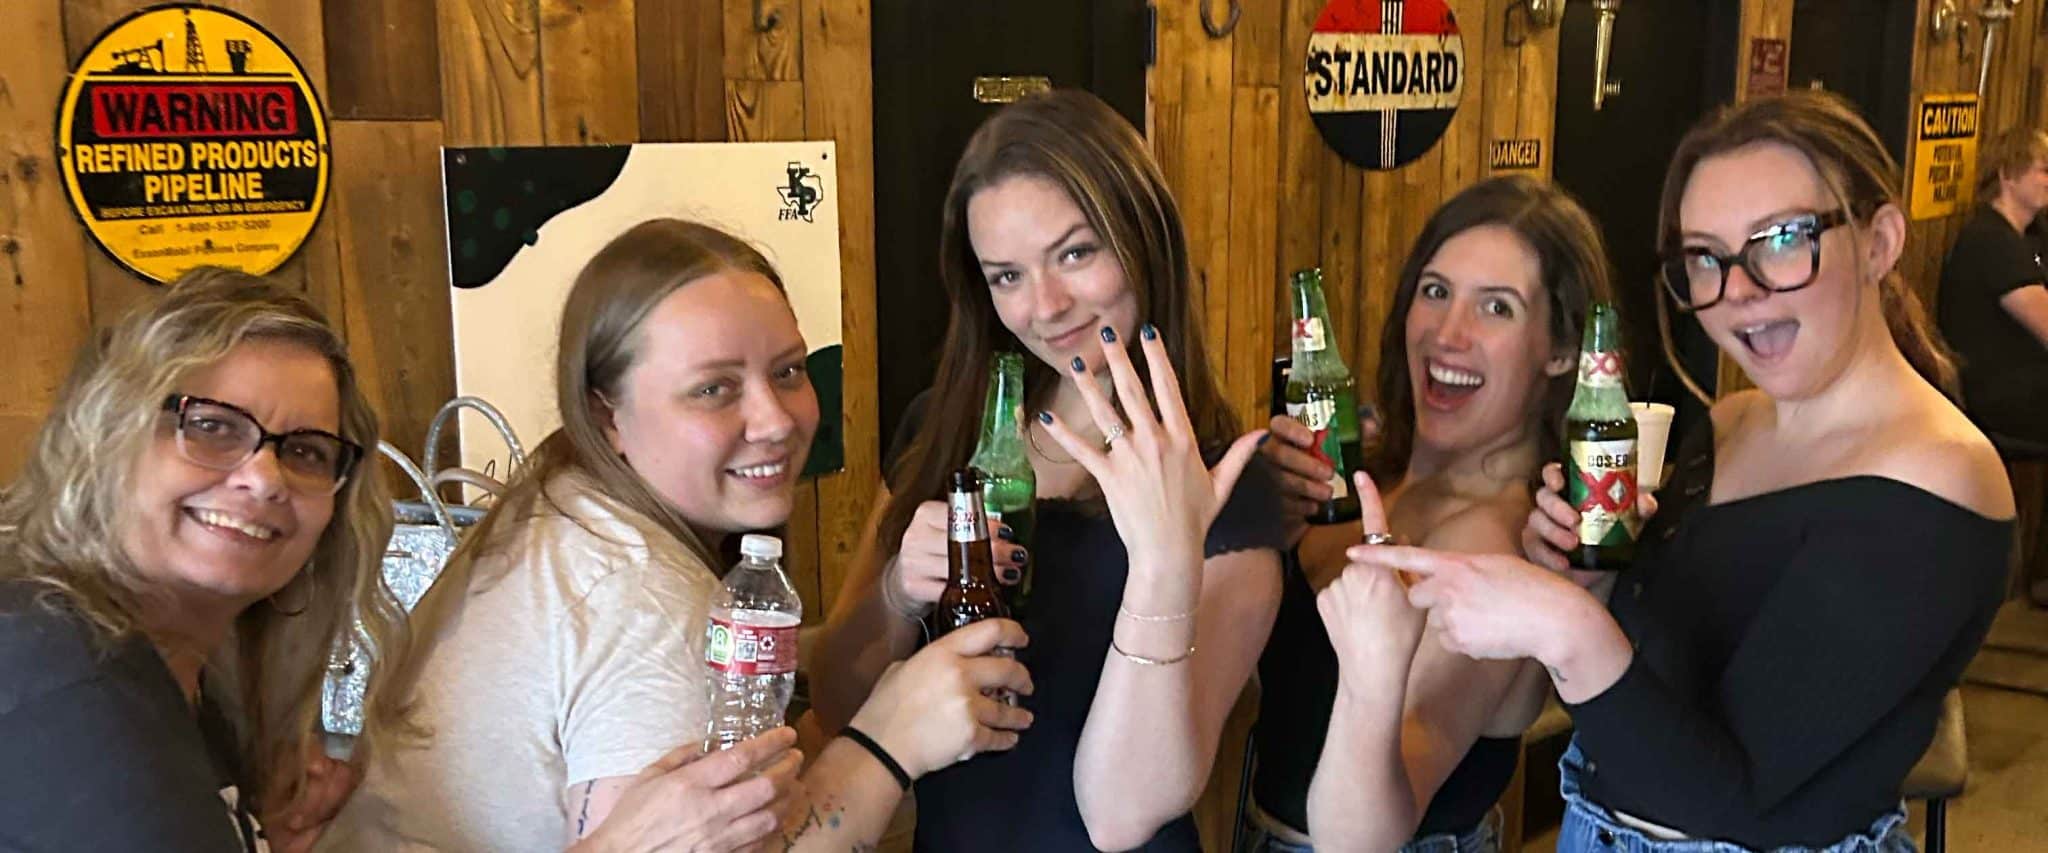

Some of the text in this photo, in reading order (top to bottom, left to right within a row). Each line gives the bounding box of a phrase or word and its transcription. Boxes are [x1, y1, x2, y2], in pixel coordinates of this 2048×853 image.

[1313, 50, 1458, 96] STANDARD
[102, 93, 288, 131] WARNING
[1925, 106, 1975, 136] CAUTION
[76, 139, 318, 173] REFINED PRODUCTS
[1492, 141, 1538, 167] DANGER
[145, 172, 263, 202] PIPELINE
[146, 203, 213, 216] EXCAVATING
[778, 207, 798, 221] FFA
[138, 224, 165, 235] Call
